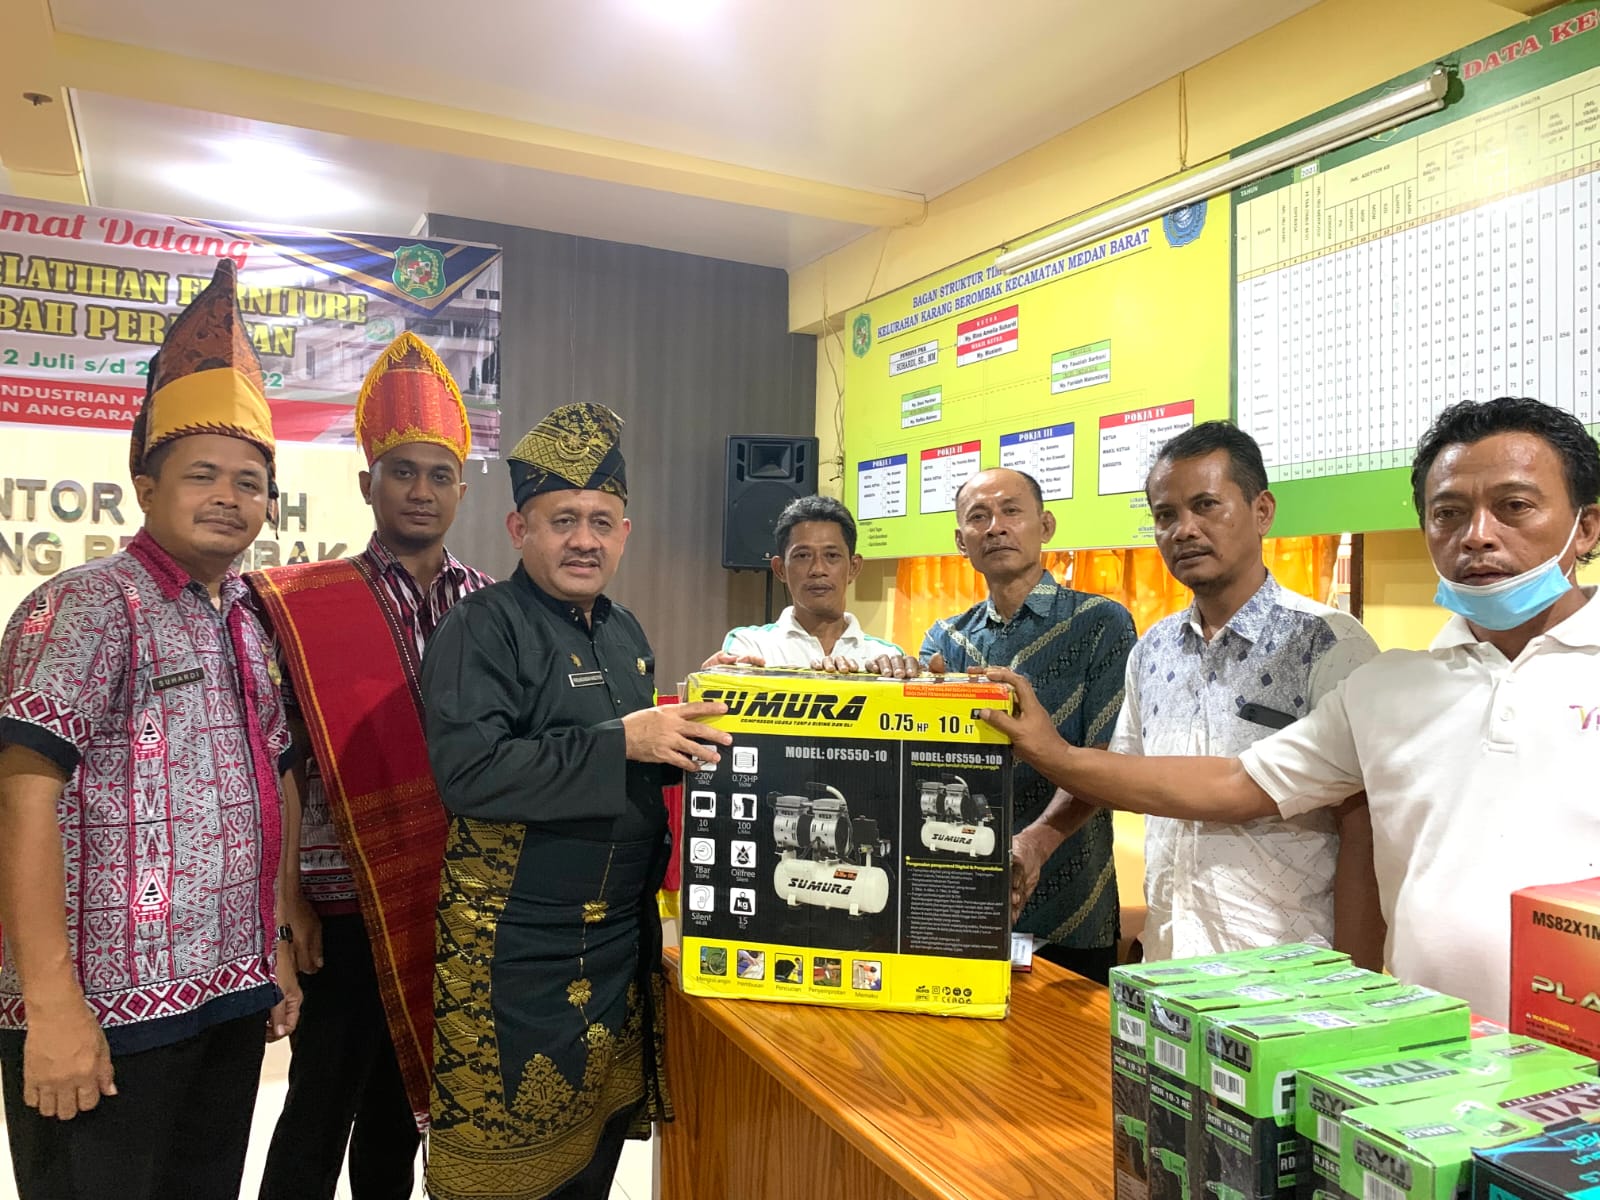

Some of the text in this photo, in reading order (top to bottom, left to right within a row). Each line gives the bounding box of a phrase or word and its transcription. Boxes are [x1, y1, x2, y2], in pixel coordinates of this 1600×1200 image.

[1462, 8, 1600, 80] DATA KE
[1240, 186, 1258, 197] TAHUN
[0, 209, 253, 270] mat Datang
[0, 252, 368, 325] LATIHAN FNITURE
[877, 228, 1149, 338] KELURAHAN KARANG BEROMBAK KECAMATAN MEDAN BARAT
[913, 289, 938, 308] BAGAN
[940, 271, 983, 298] STRUKTUR
[0, 295, 77, 337] BAH
[28, 352, 75, 370] Juli
[84, 358, 126, 374] s/d
[0, 384, 126, 405] NDUSTRIAN
[26, 403, 141, 422] ANGGARA
[1124, 408, 1165, 424] POKJA IV
[1018, 428, 1053, 442] POKJA III
[880, 713, 974, 734] 0.75 HP 10 LT
[785, 746, 888, 762] MODEL: OFS550-10
[911, 751, 944, 763] MODEL:
[732, 774, 758, 783] 0.75HP
[699, 819, 709, 827] 10
[737, 821, 751, 830] 100
[931, 833, 973, 845] SUMURA
[694, 865, 711, 874] 7Bar
[731, 868, 756, 878] Oilfree
[788, 877, 853, 895] SUMURA
[737, 899, 749, 910] kg
[691, 912, 712, 921] Silent
[738, 916, 748, 925] 15
[1336, 1060, 1438, 1081] RYU
[1356, 1139, 1409, 1178] RYU
